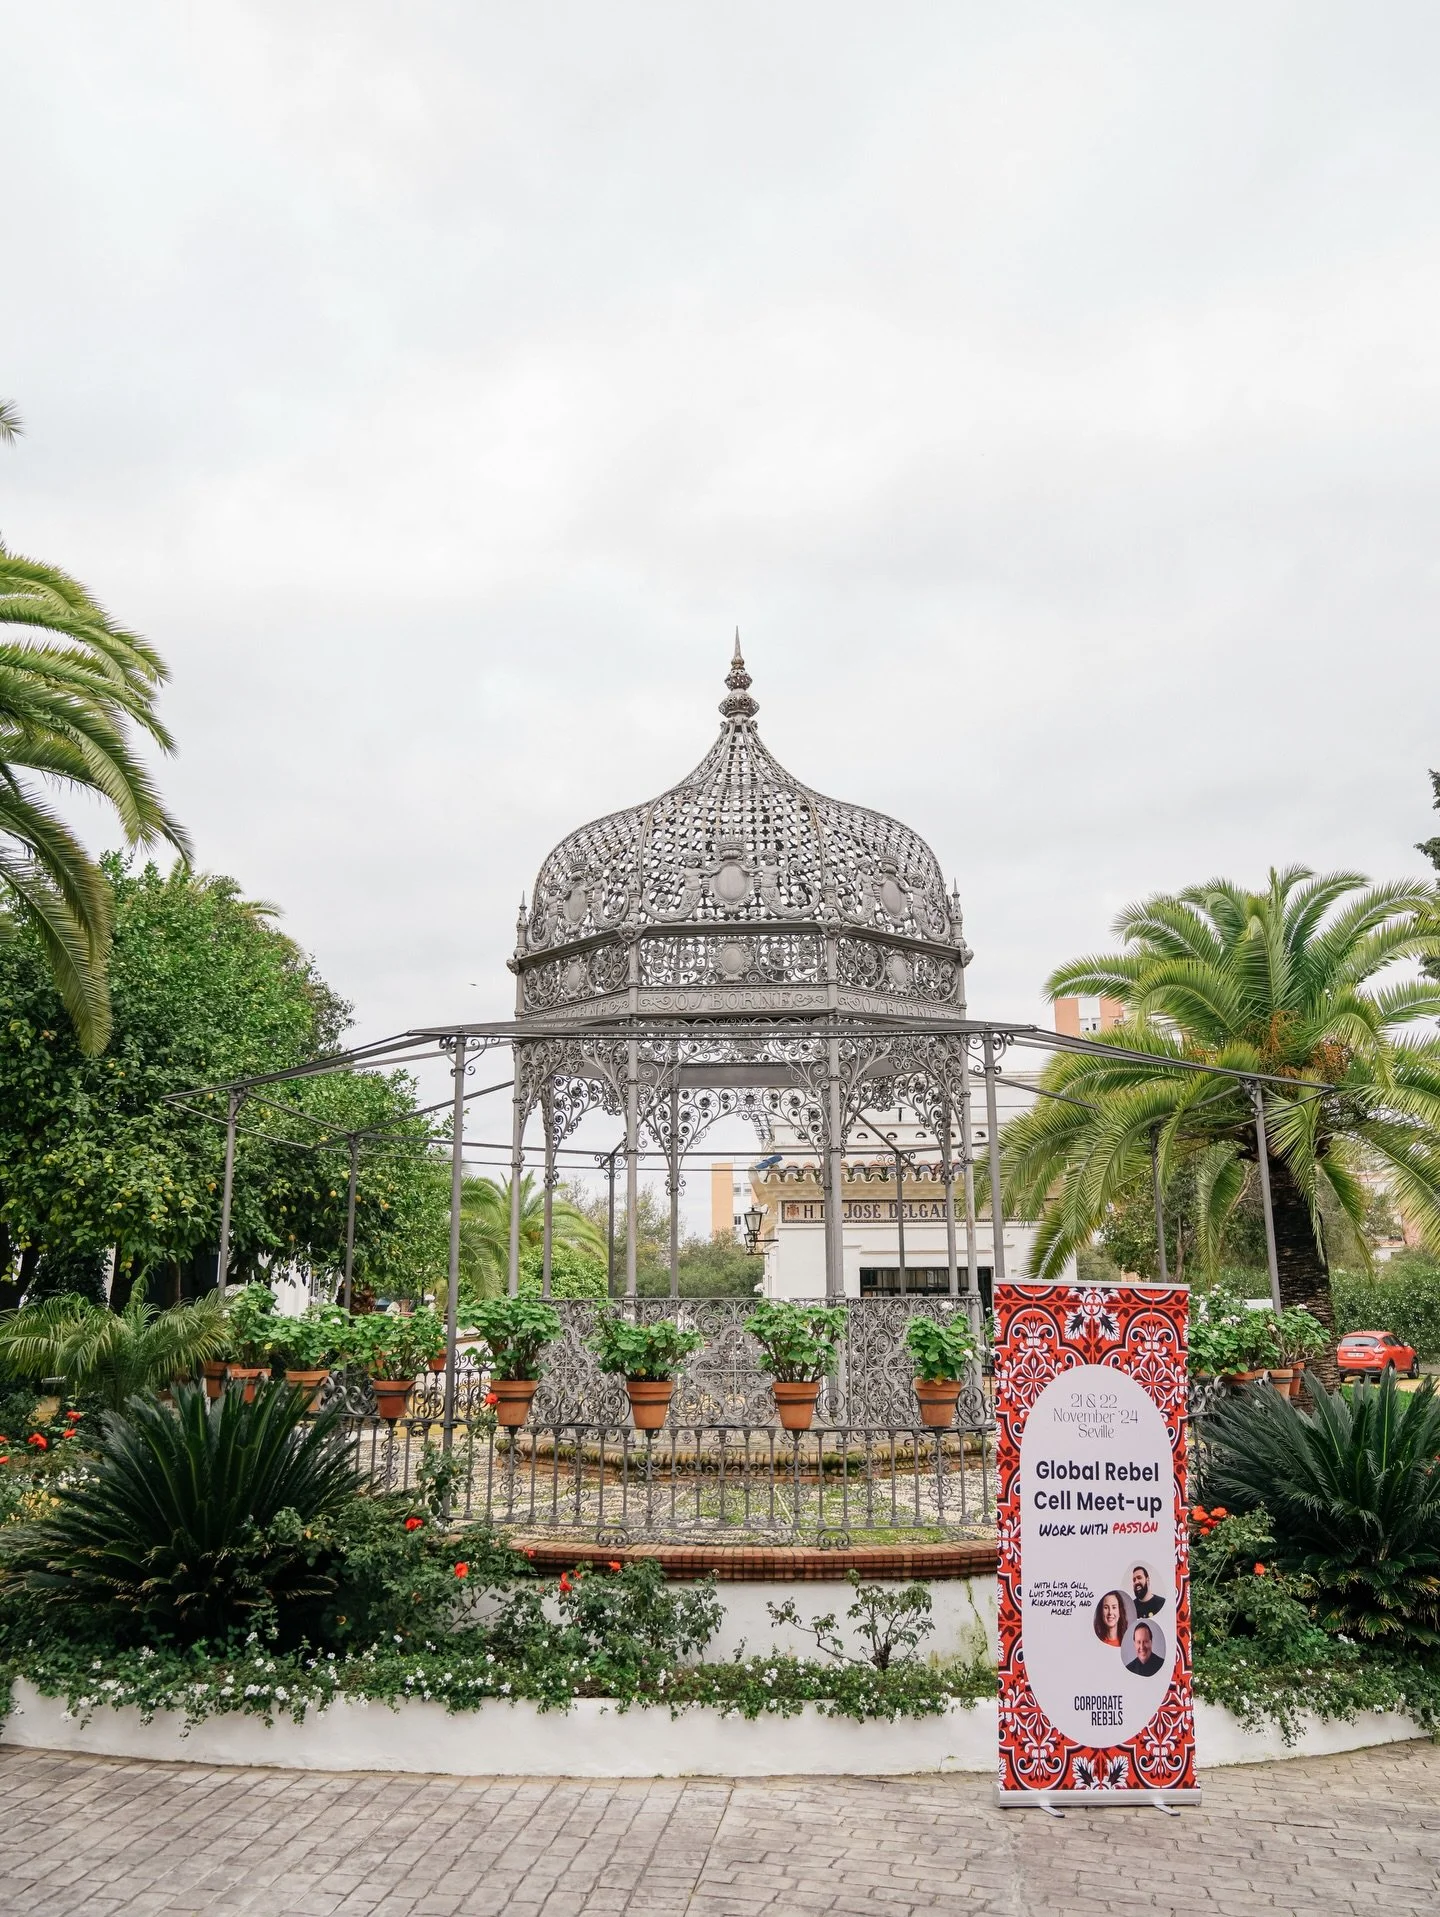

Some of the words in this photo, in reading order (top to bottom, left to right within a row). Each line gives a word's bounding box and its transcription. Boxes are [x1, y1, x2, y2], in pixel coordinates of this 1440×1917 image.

[675, 991, 793, 1010] OSBORNE
[1071, 1393, 1083, 1408] 21
[1086, 1394, 1097, 1408] &
[1099, 1394, 1118, 1409] 22
[1053, 1407, 1115, 1424] November
[1078, 1423, 1115, 1438] Seville
[1036, 1460, 1099, 1480] Global
[1105, 1462, 1159, 1481] Rebel
[1034, 1490, 1071, 1510] Cell
[1077, 1492, 1162, 1518] Meet-up
[1039, 1523, 1076, 1536] WORK
[1080, 1523, 1108, 1536] WITH
[1113, 1521, 1159, 1534] PASSION
[1074, 1695, 1123, 1711] CORPORATE
